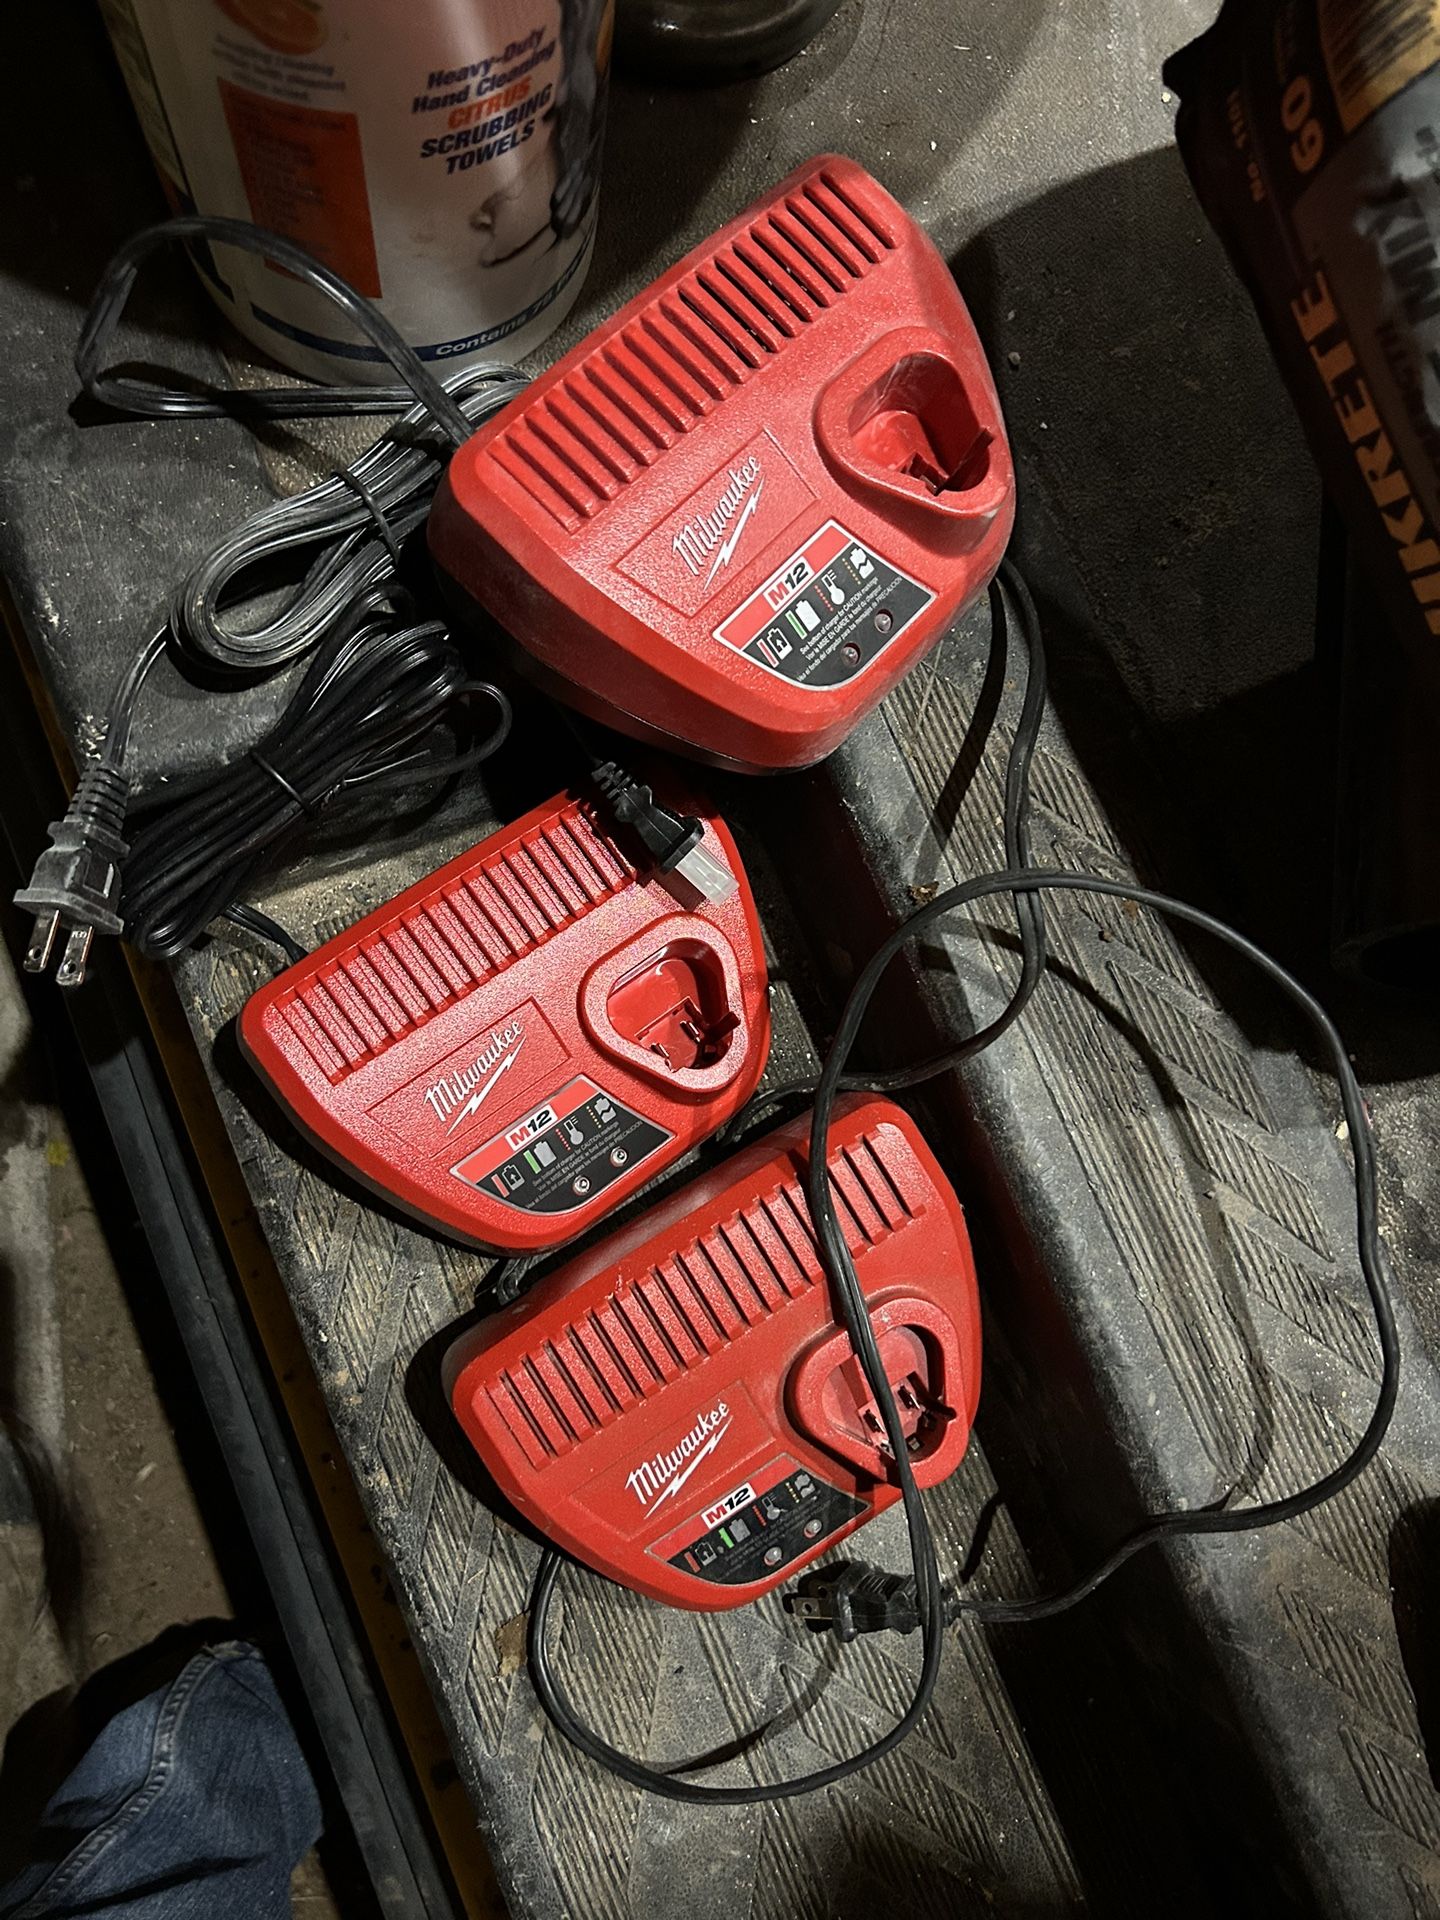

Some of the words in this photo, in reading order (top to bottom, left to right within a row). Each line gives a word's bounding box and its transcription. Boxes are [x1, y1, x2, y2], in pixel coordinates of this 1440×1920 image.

[412, 85, 470, 114] Hand
[477, 39, 556, 96] Cleaning
[427, 27, 545, 89] Heavy-Duty
[420, 83, 553, 158] SCRUBBING
[447, 76, 532, 129] CITRUS
[1280, 73, 1326, 175] 60
[446, 119, 536, 174] TOWELS
[434, 312, 528, 356] Contains
[672, 455, 762, 577] Milwaukee
[768, 563, 808, 604] M12
[807, 631, 822, 646] bottom
[823, 614, 841, 631] charger
[842, 591, 863, 611] CAUTION
[816, 636, 829, 648] MISE
[832, 616, 850, 632] GARDE
[423, 1021, 524, 1122] Milwaukee
[510, 1109, 552, 1146] M12
[580, 1133, 601, 1150] CAUTION
[624, 1399, 730, 1504] Milwaukee
[706, 1487, 750, 1524] M12
